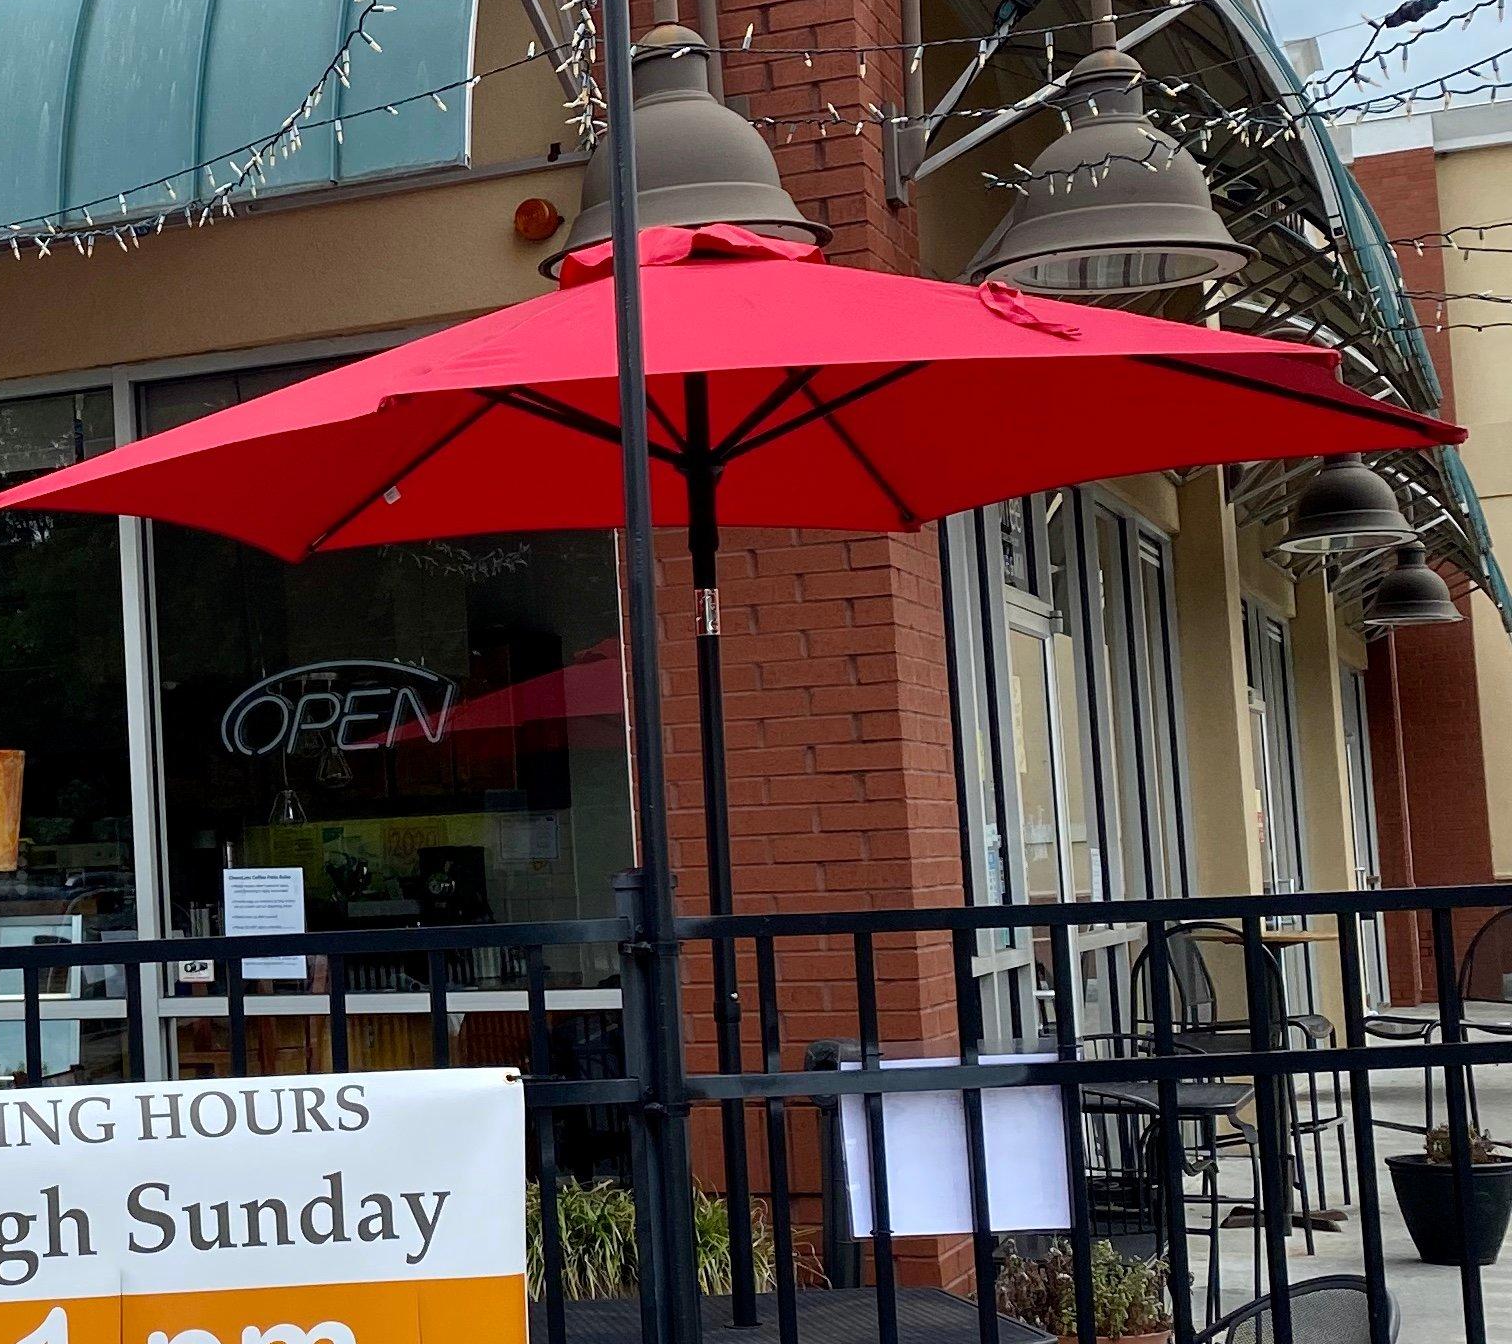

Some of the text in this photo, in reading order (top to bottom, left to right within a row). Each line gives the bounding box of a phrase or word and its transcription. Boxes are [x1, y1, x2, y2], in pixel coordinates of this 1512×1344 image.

[233, 683, 455, 756] OPEN
[134, 1084, 371, 1142] HOURS
[126, 1171, 451, 1264] Sunday
